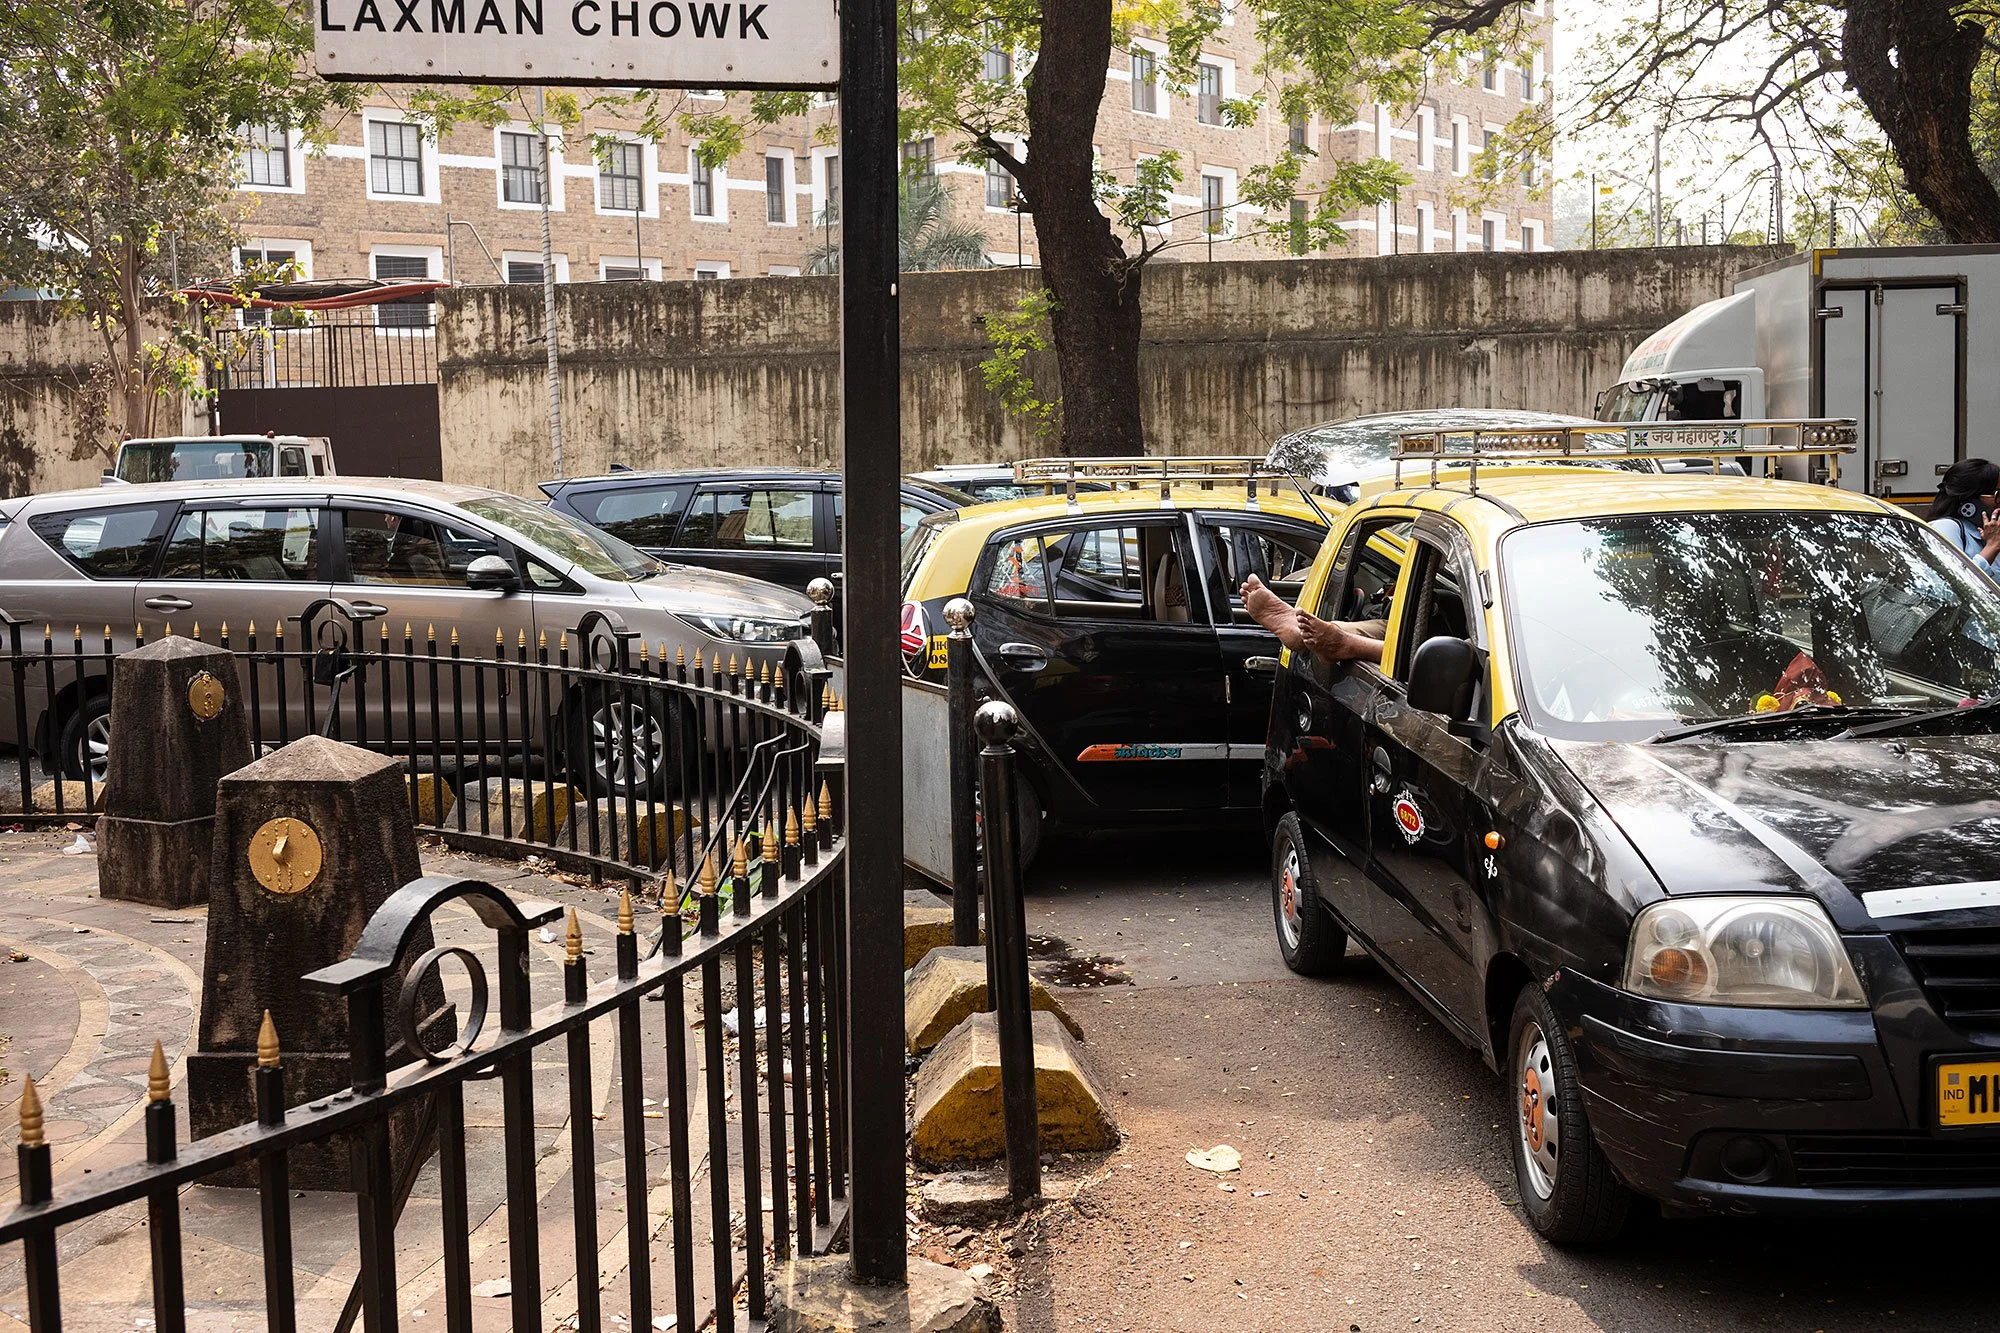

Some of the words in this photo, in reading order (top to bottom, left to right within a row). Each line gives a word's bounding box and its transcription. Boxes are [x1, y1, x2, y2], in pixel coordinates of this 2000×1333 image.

[321, 0, 544, 35] LAXMAN
[571, 0, 770, 40] CHOWK
[1652, 431, 1674, 444] जय
[1676, 430, 1721, 447] महाराष्ट्र
[1943, 1089, 1965, 1101] IND
